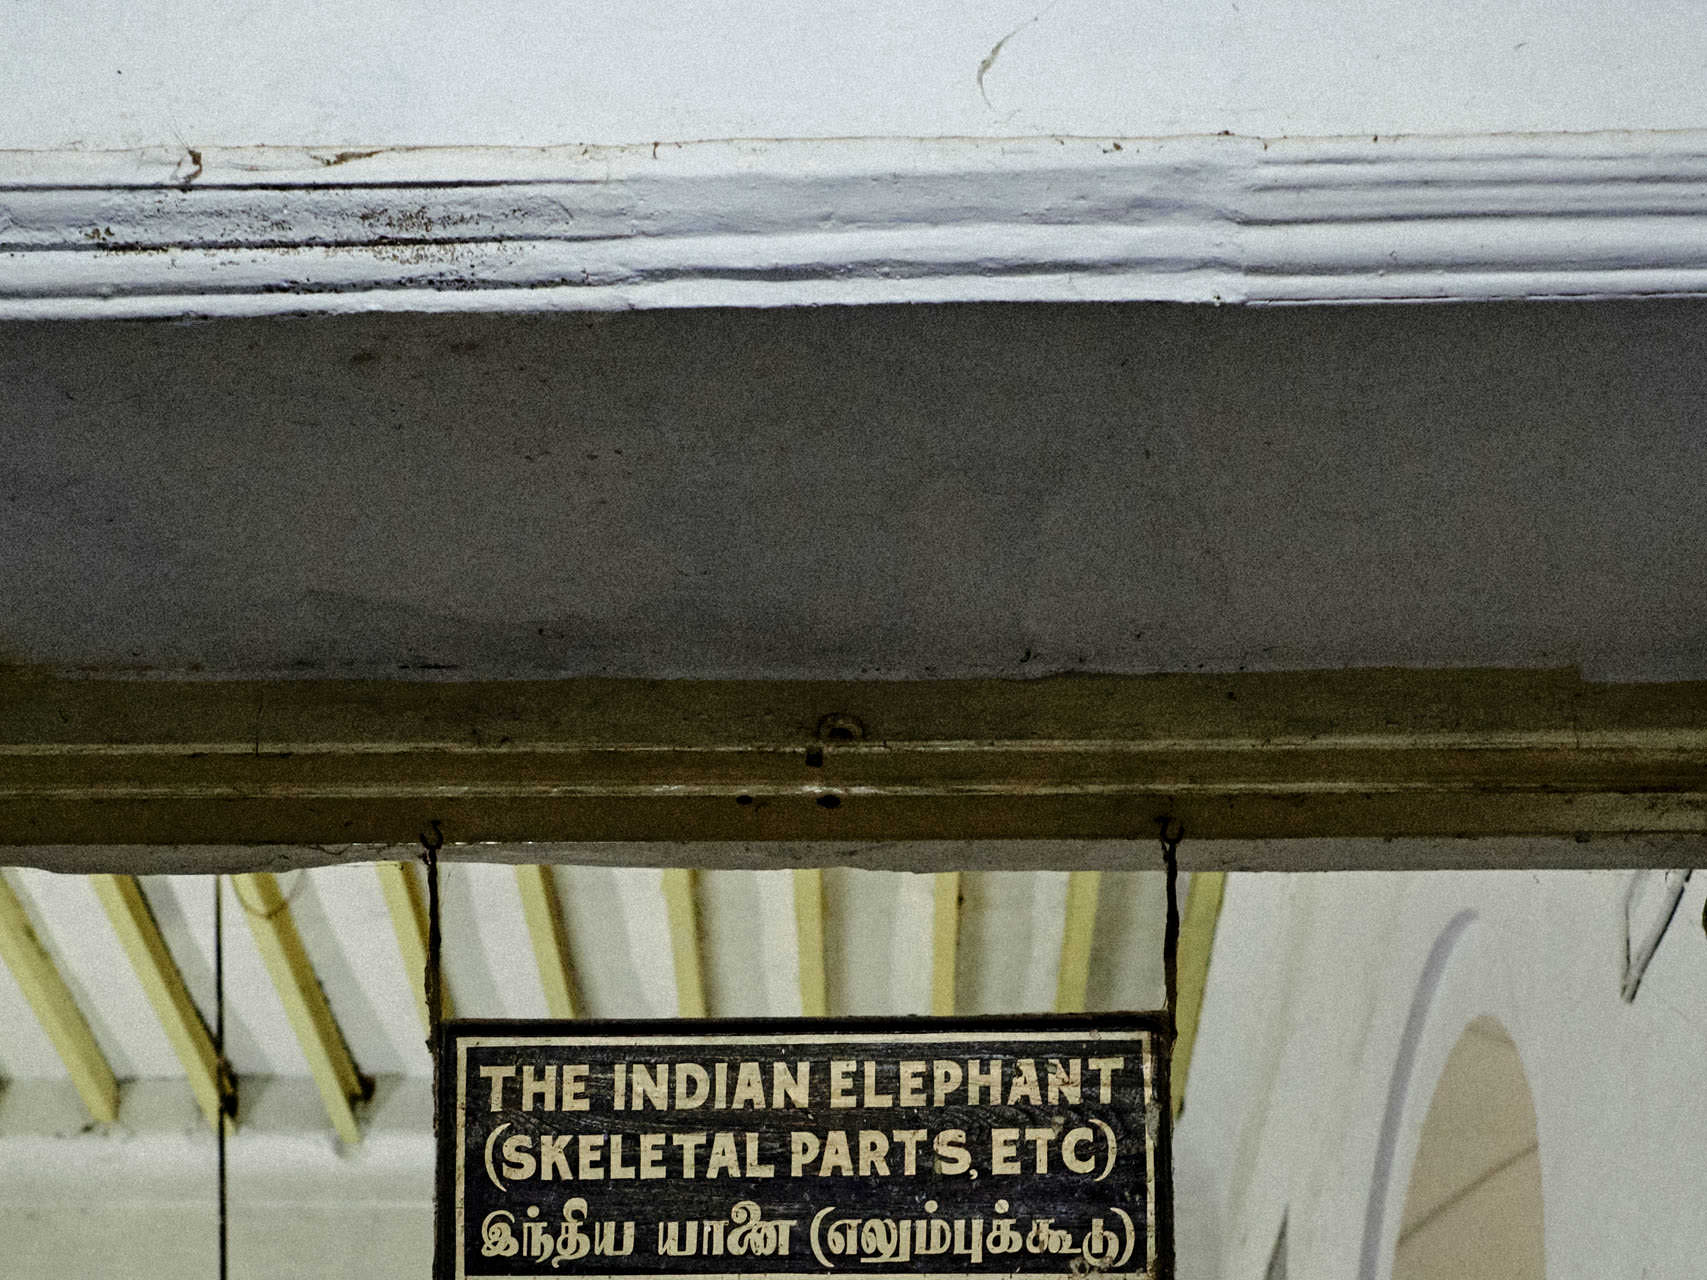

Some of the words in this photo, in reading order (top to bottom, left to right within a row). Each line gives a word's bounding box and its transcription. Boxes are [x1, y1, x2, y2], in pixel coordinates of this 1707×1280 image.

[480, 1065, 591, 1113] THE
[613, 1061, 811, 1112] INDIAN
[830, 1057, 1125, 1109] ELEPHANT
[484, 1122, 776, 1193] (SKELETAL
[790, 1128, 978, 1180] PARTS,
[991, 1118, 1117, 1182] ETC)
[481, 1197, 636, 1268] இந்திய
[658, 1200, 798, 1257] யானை
